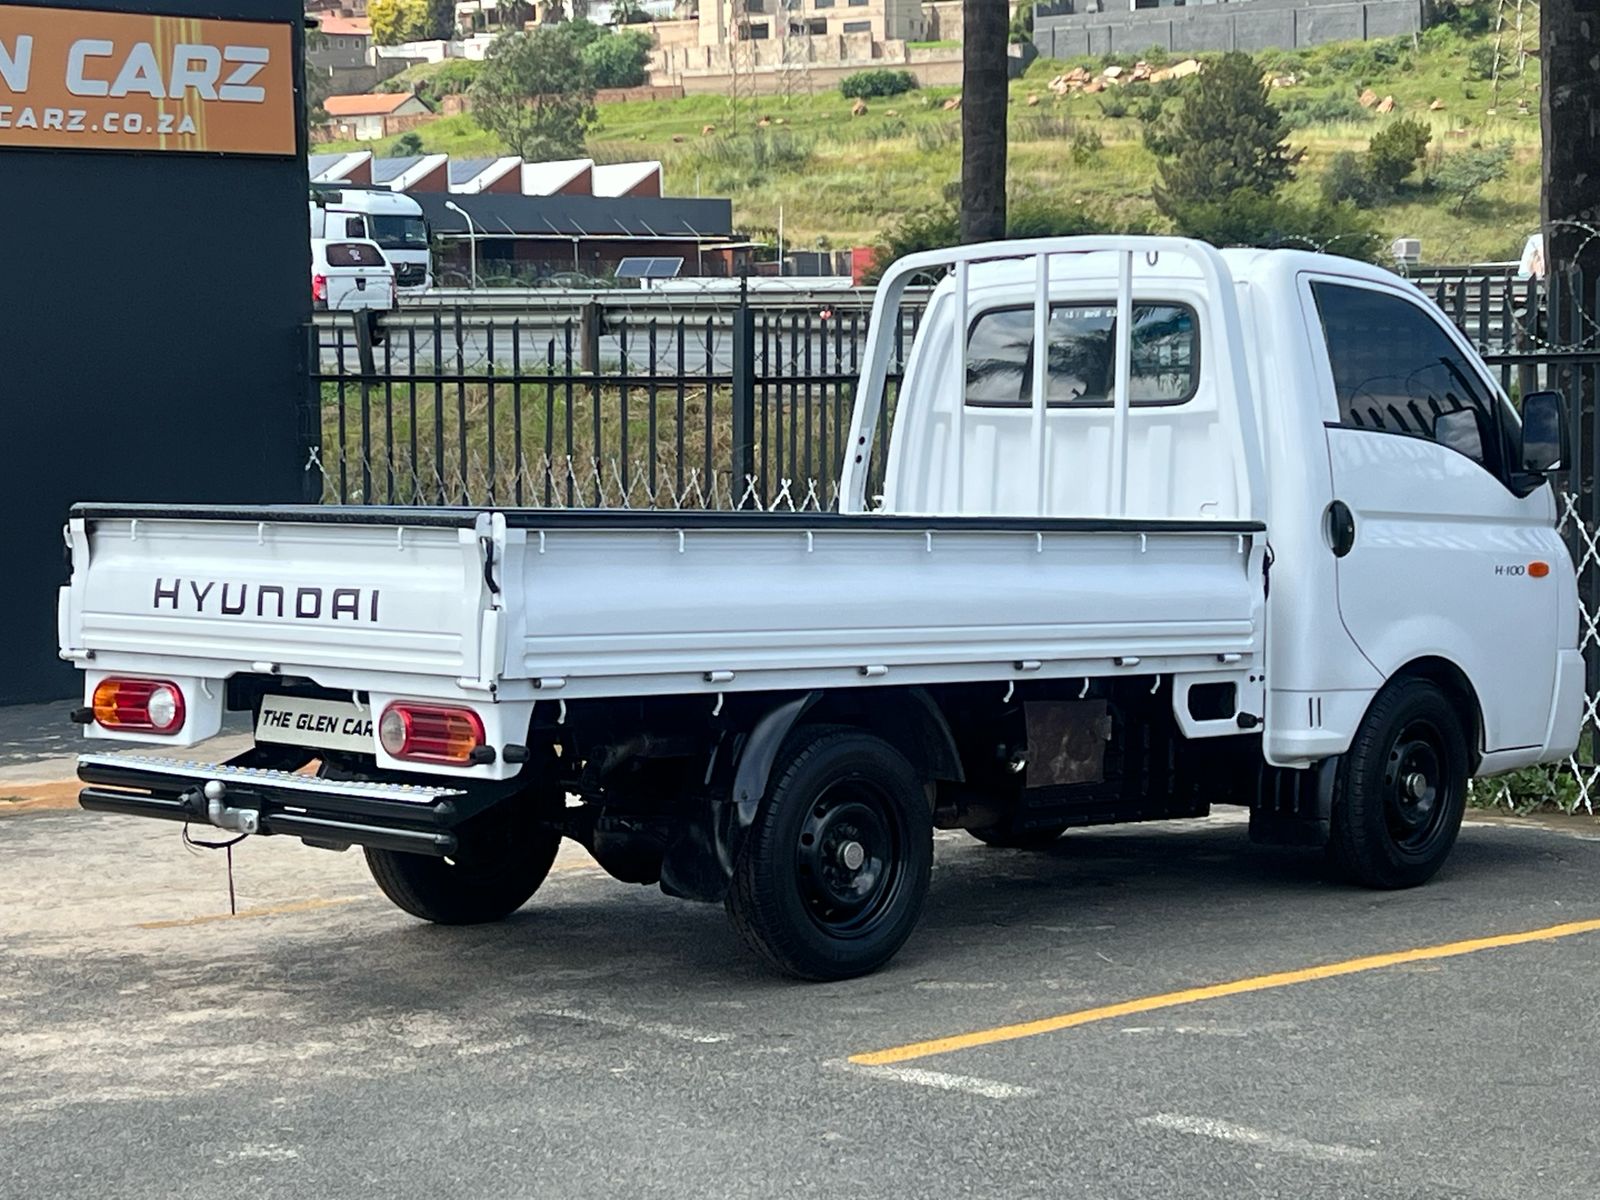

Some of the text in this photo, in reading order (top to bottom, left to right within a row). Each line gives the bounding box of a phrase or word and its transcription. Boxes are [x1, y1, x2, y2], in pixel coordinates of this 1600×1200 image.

[66, 39, 270, 102] CARZ
[153, 578, 380, 622] HYUNDAI
[263, 710, 293, 728] THE
[296, 714, 339, 733] GLEN
